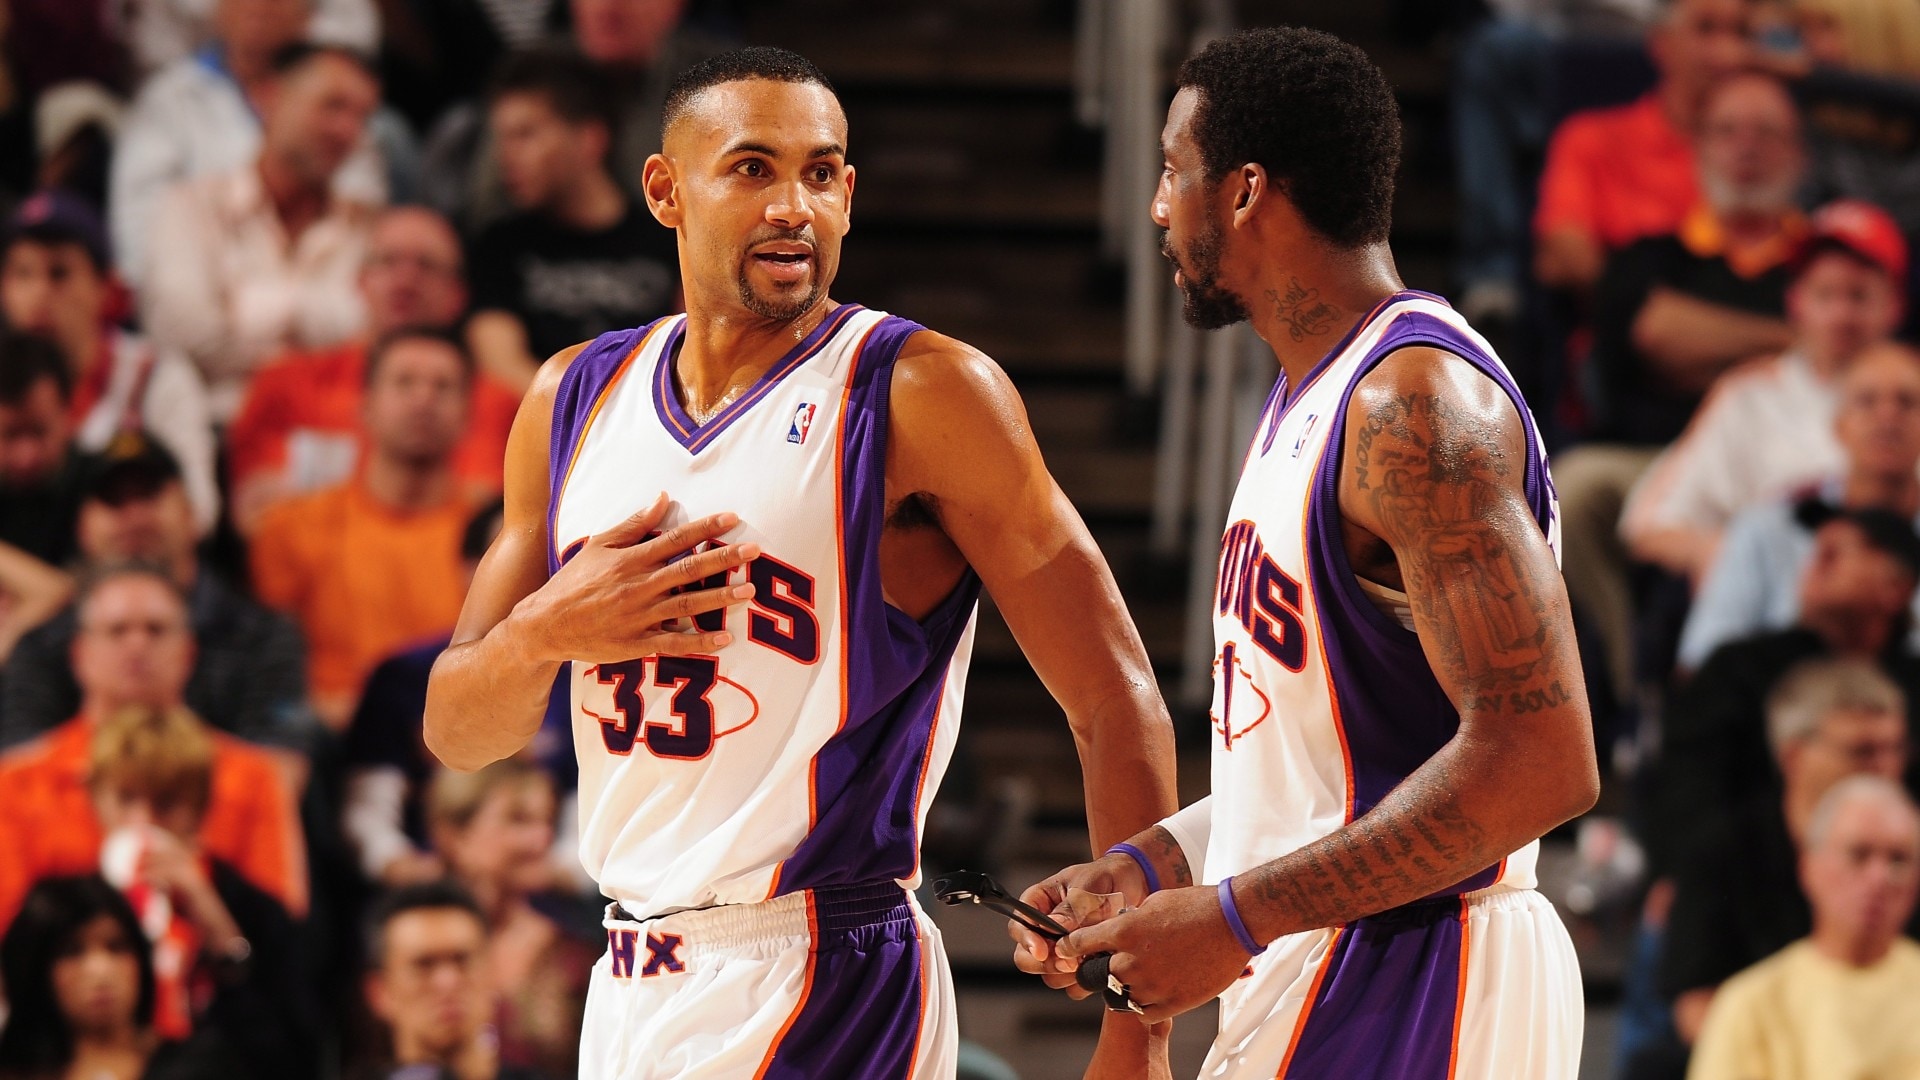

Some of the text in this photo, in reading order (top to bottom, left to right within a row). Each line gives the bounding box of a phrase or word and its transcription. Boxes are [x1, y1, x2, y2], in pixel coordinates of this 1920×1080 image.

[1219, 518, 1308, 674] UNS
[597, 653, 720, 761] 33
[607, 928, 686, 979] HX
